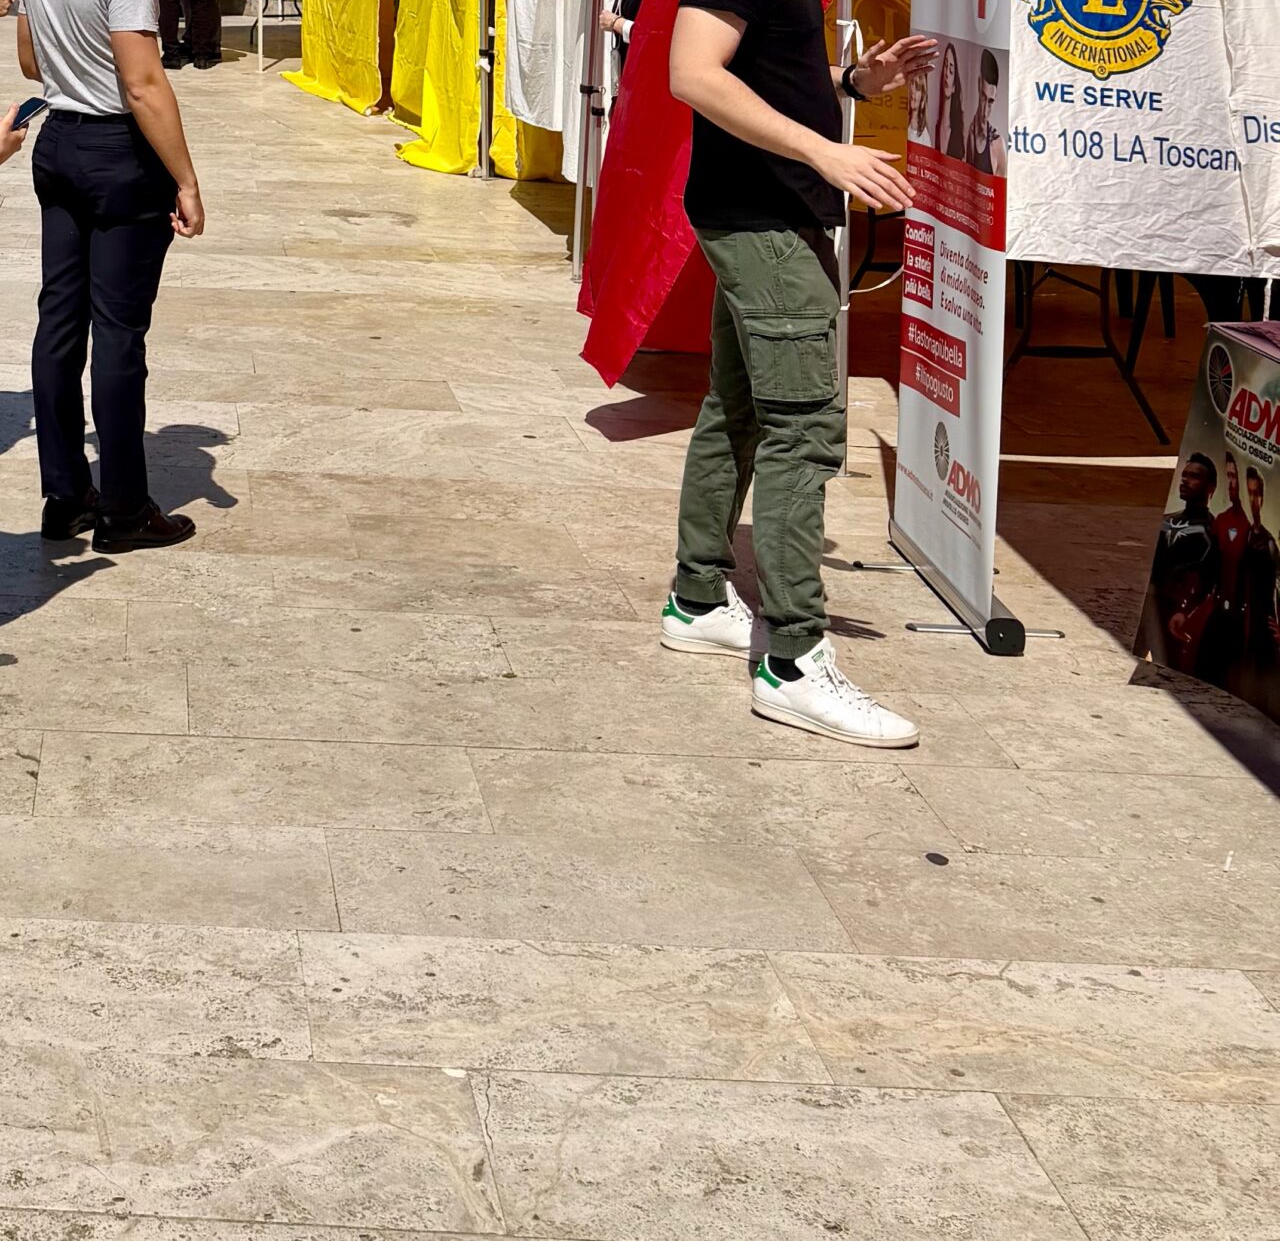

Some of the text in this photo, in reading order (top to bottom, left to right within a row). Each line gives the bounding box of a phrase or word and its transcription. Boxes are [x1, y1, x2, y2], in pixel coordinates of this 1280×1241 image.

[1050, 27, 1153, 66] INTERNATIONAL
[1035, 81, 1163, 112] WE SERVE
[1007, 125, 1241, 172] tto 108 LA Toscan
[905, 223, 934, 246] Condividi
[907, 250, 914, 267] la
[940, 240, 964, 268] Diventa
[1248, 445, 1274, 465] OSSEO
[947, 459, 982, 514] ADMO
